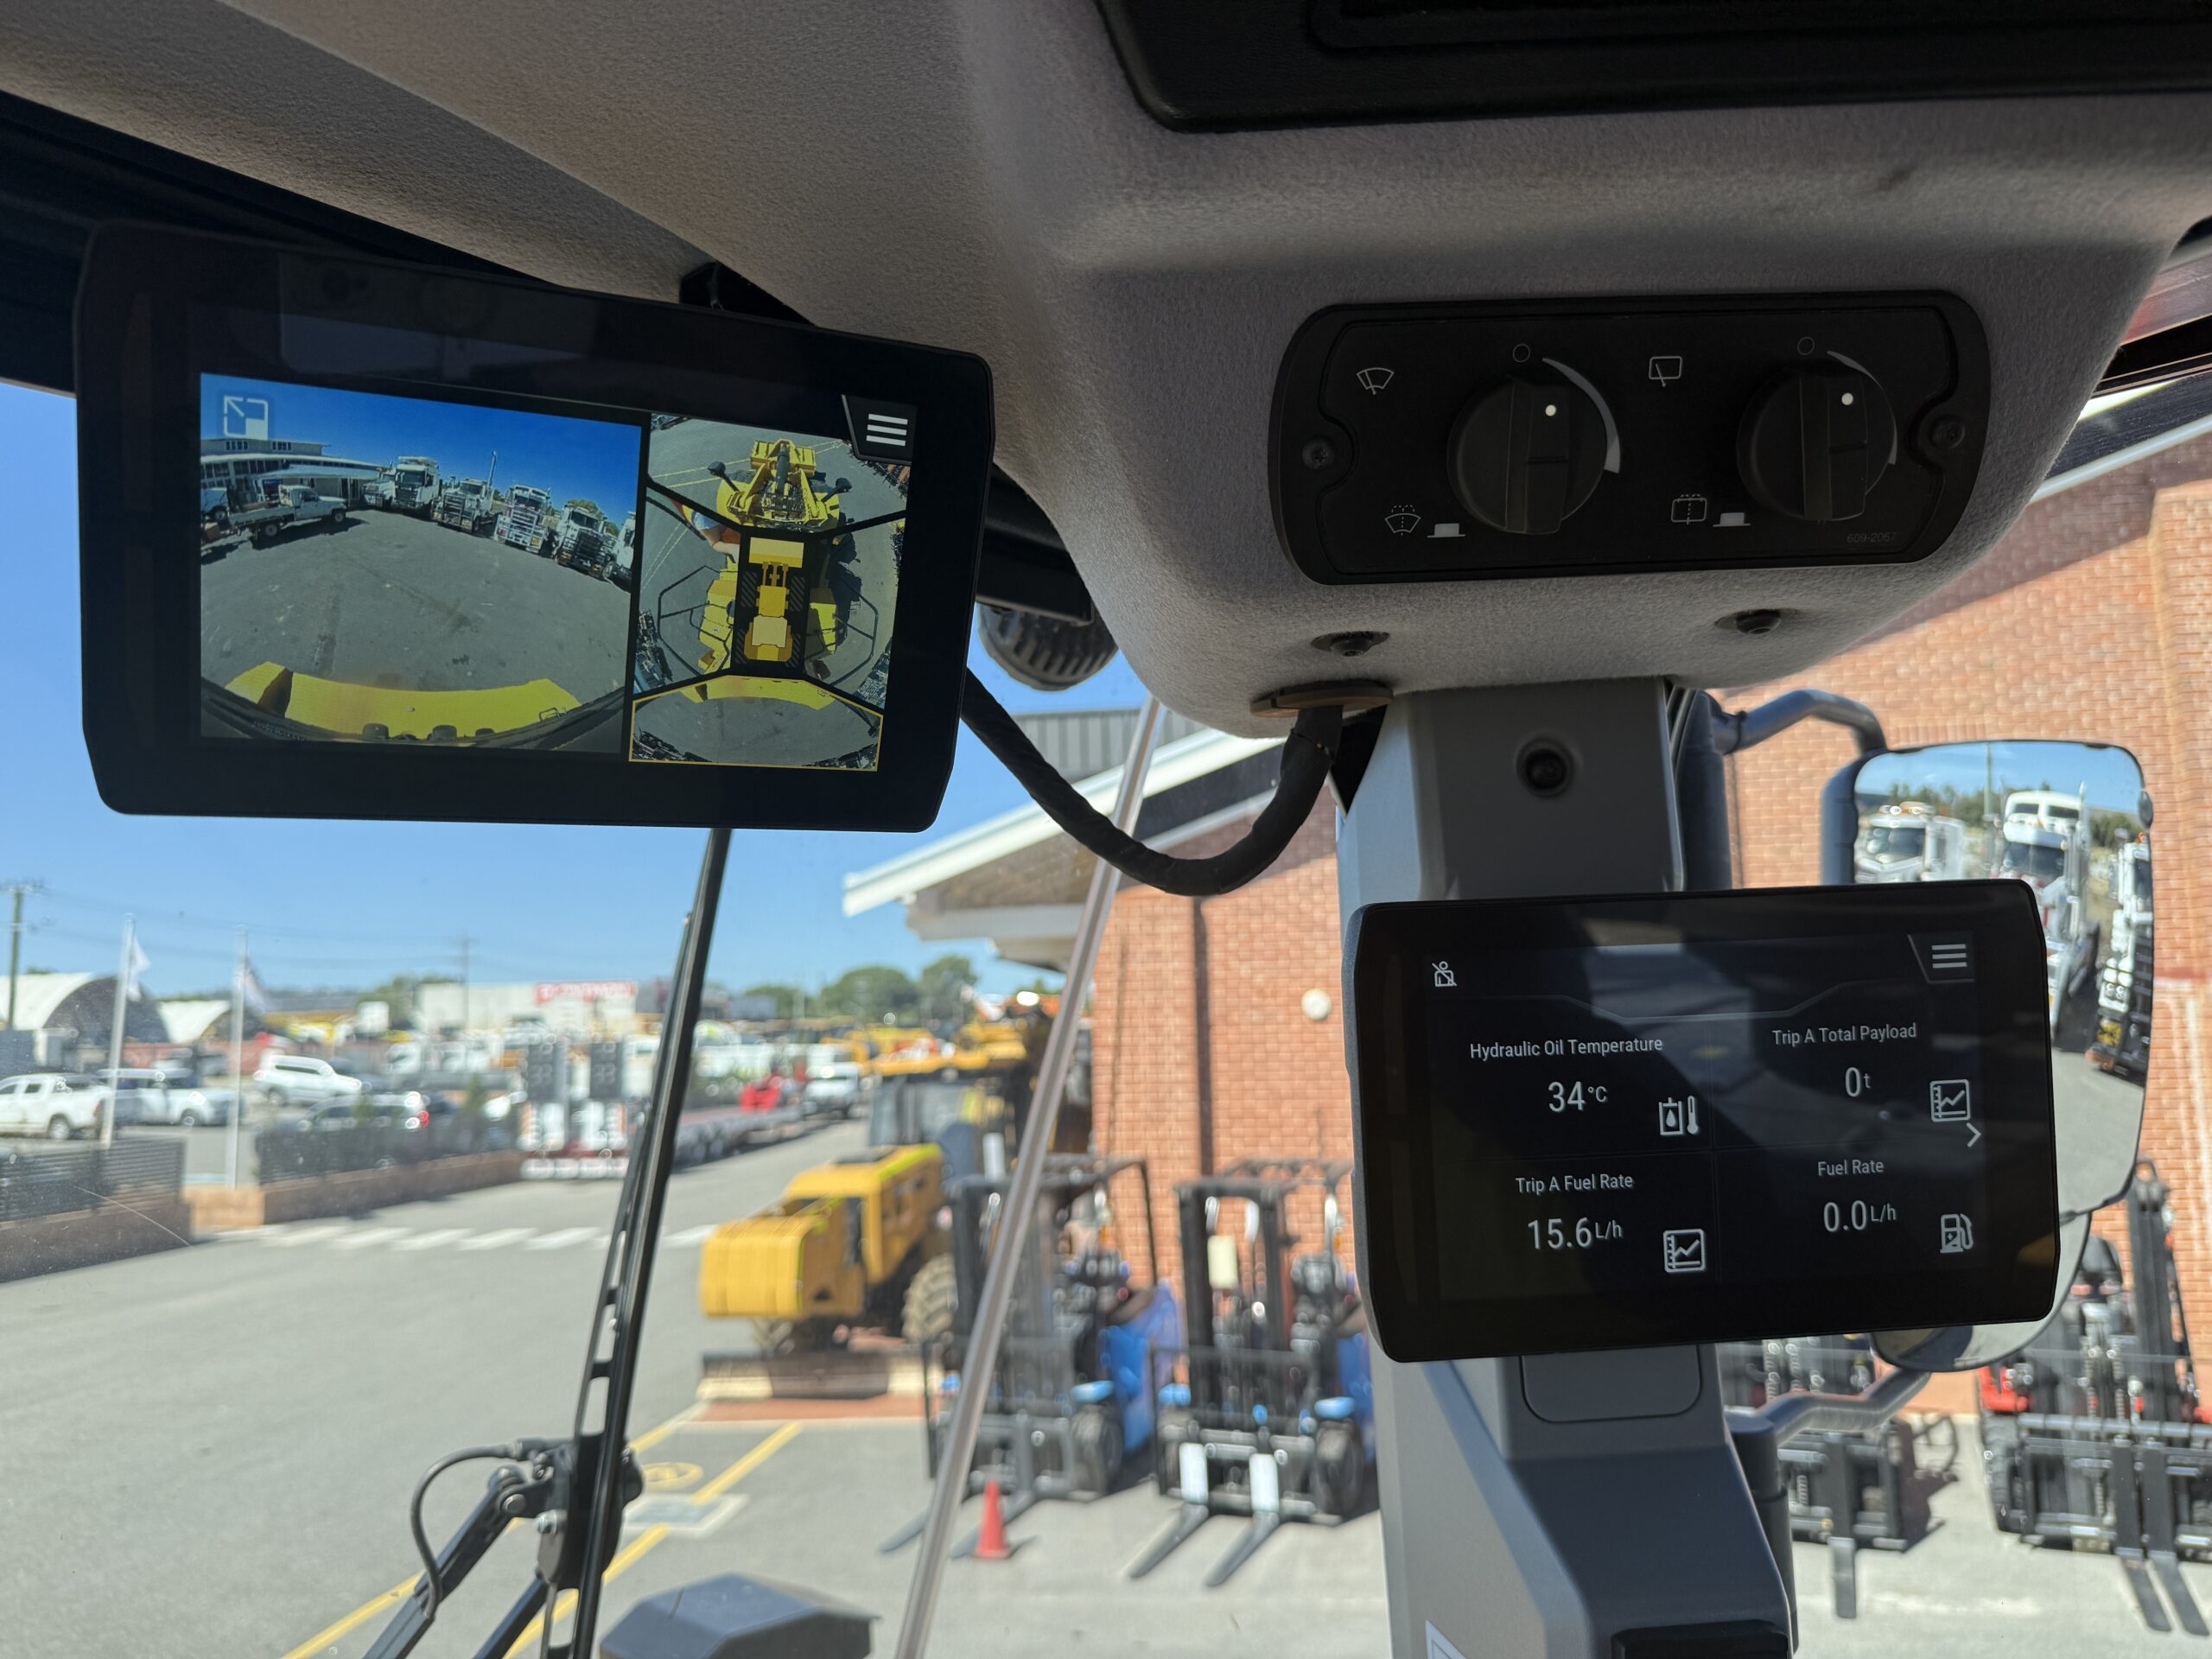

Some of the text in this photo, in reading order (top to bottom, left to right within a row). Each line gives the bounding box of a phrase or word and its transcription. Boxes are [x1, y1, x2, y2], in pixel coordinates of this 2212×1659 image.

[1846, 531, 1897, 543] 609-2067
[1772, 1023, 1917, 1048] Trip A Total Payload
[1470, 1038, 1663, 1062] Hydraulic Oil Temperature
[1818, 1158, 1885, 1177] Fuel Rate
[1516, 1173, 1634, 1196] Trip A Fuel Rate
